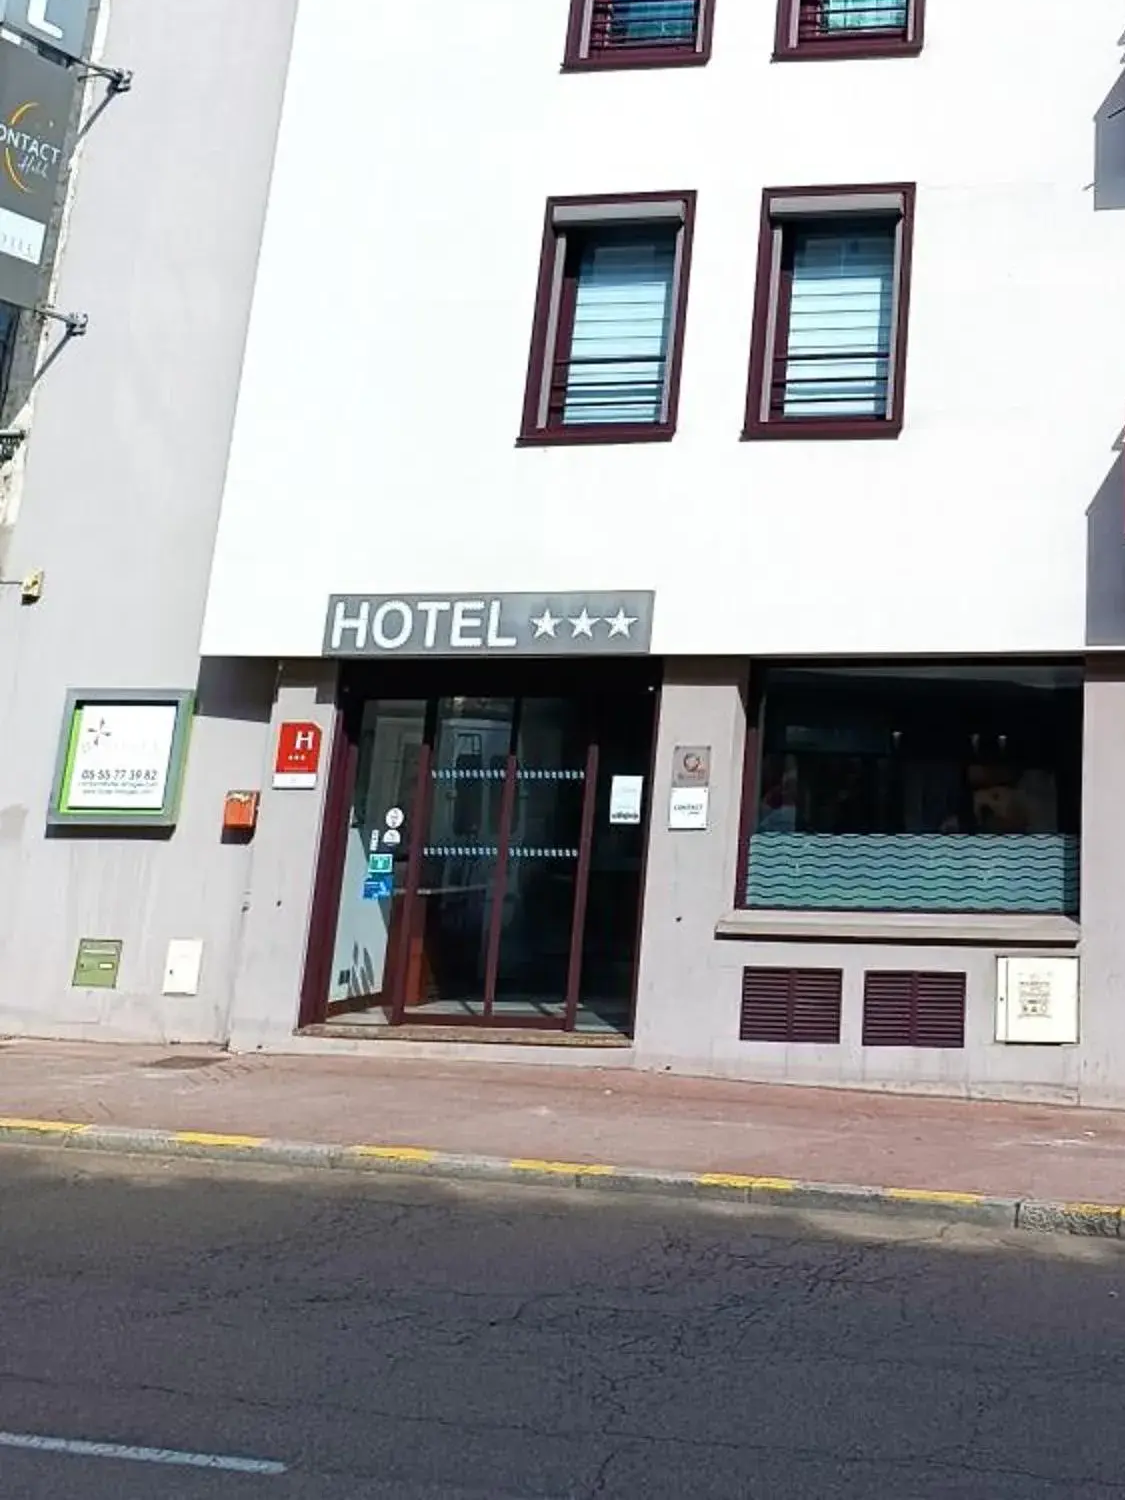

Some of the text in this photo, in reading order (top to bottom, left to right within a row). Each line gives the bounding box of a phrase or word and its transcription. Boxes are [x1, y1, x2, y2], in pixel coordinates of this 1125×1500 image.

[331, 599, 517, 649] HOTEL
[295, 731, 314, 750] H
[114, 769, 127, 780] 77
